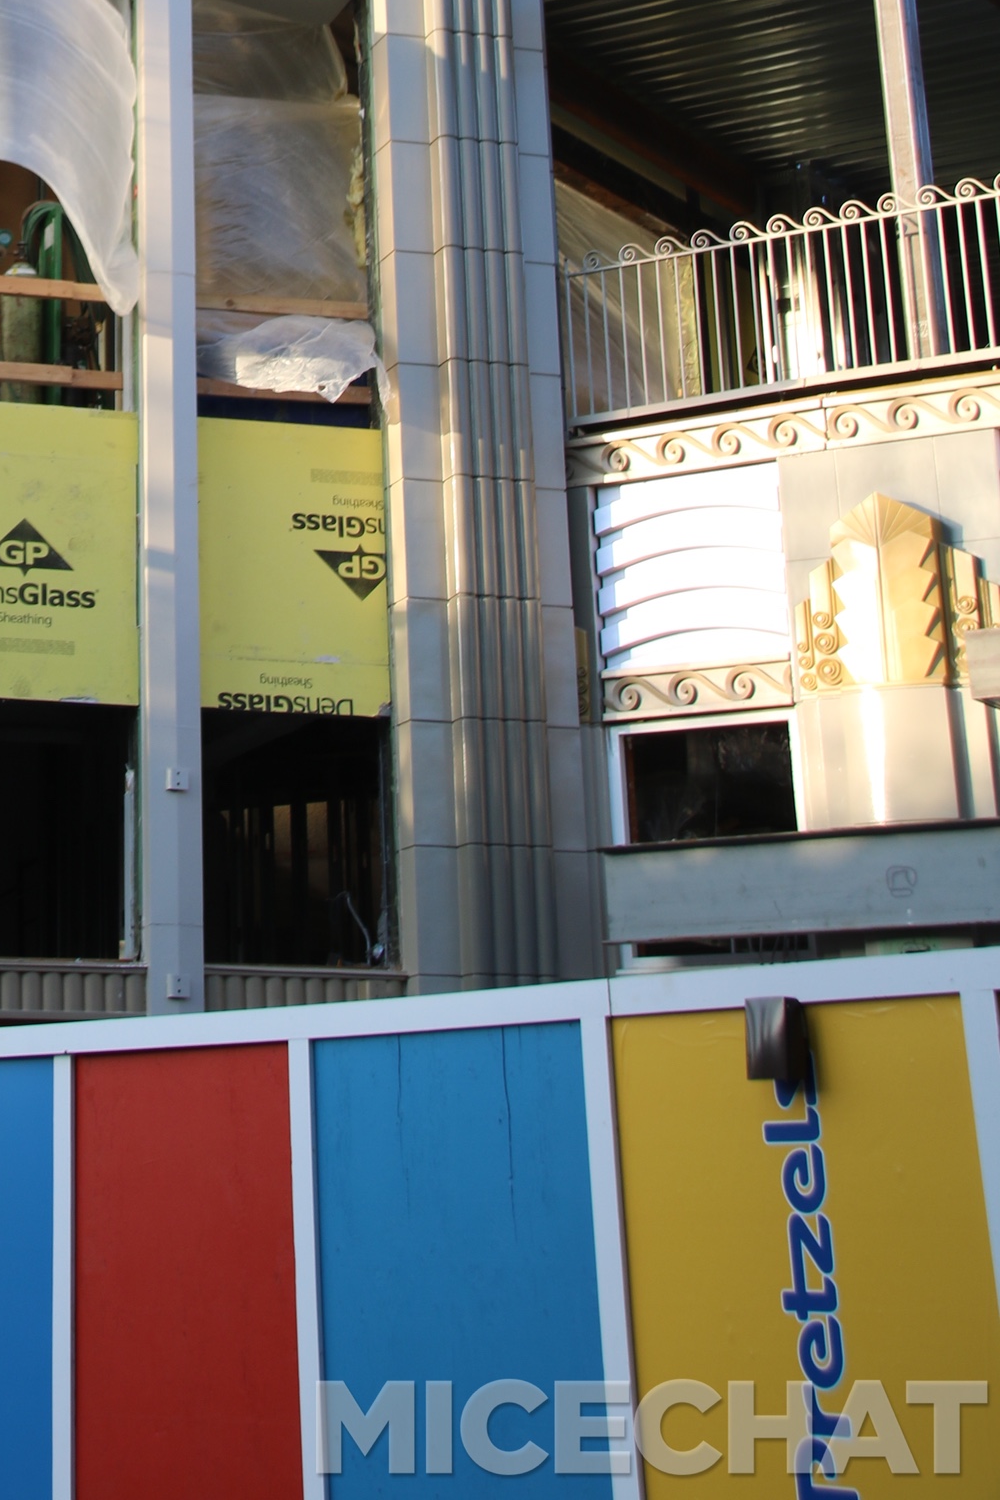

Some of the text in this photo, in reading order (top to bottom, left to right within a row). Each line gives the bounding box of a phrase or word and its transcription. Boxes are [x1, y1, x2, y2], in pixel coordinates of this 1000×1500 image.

[337, 554, 386, 581] GP
[259, 672, 313, 689] Sheathing
[218, 692, 354, 716] DensGlass
